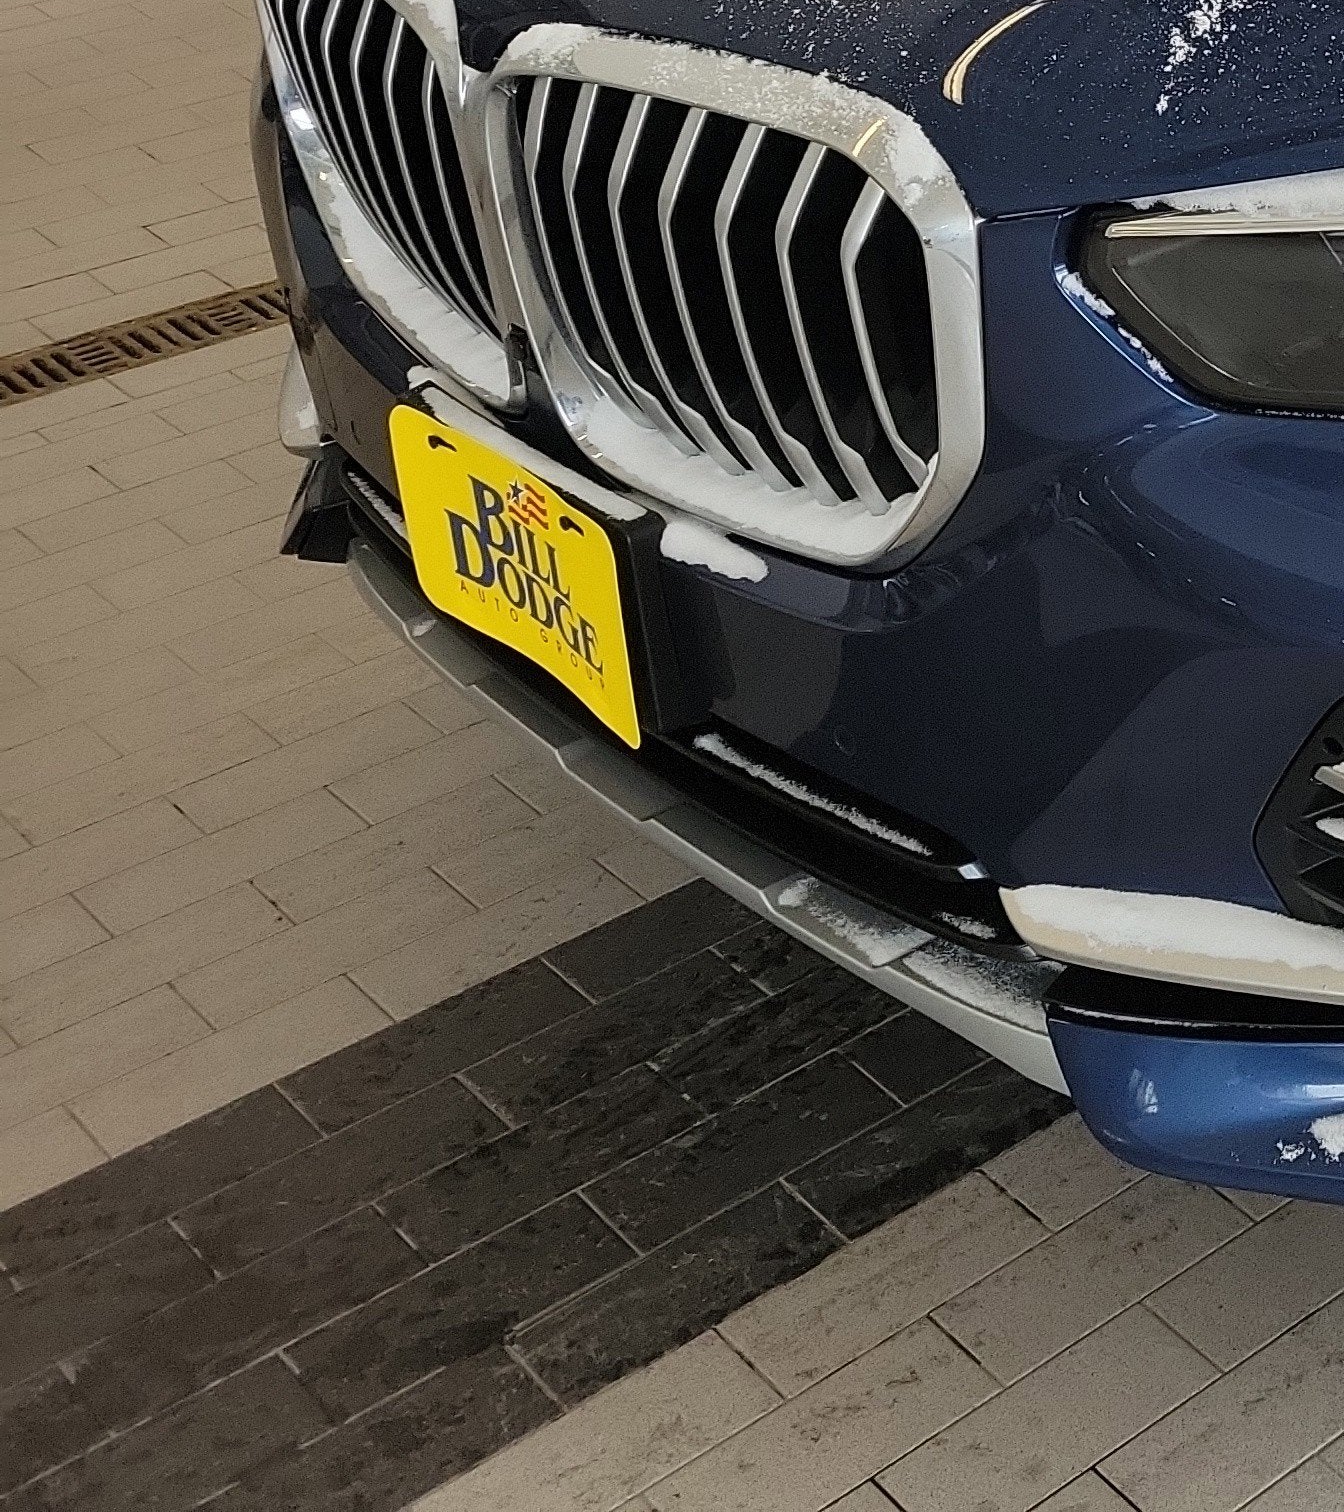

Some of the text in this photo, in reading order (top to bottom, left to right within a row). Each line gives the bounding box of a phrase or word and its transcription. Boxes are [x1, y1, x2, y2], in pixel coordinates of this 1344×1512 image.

[444, 508, 604, 677] DODGE
[467, 473, 571, 604] BILL
[460, 579, 605, 689] AUTO GROUP
